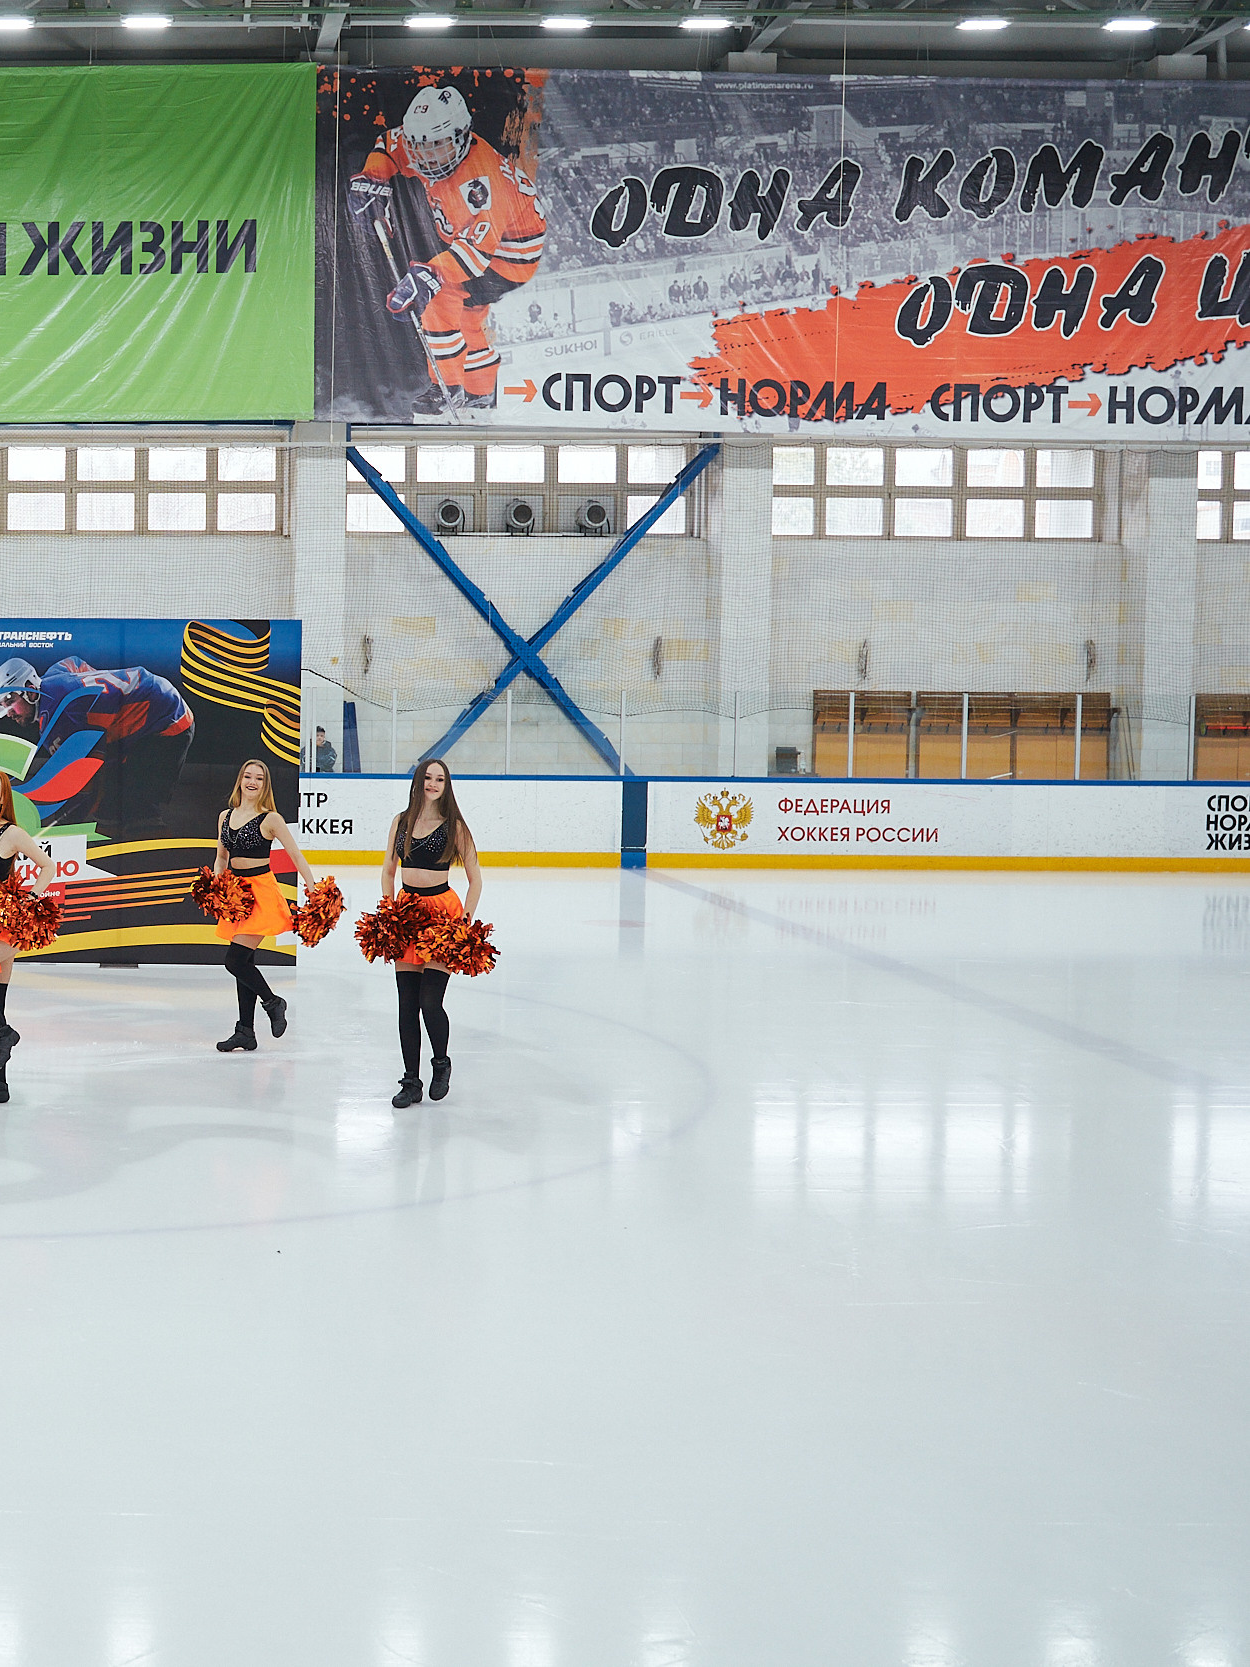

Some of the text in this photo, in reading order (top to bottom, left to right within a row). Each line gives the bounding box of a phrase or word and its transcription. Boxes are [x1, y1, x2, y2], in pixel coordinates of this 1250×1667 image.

[714, 80, 814, 91] www.platinumarena.ru
[590, 157, 862, 249] ОДНА
[893, 128, 1250, 224] КОМАН
[18, 219, 258, 276] ЖИЗНИ
[896, 254, 1166, 348] ОДНА
[638, 325, 680, 341] ERIELL
[544, 338, 598, 358] SUKHOI
[542, 372, 1250, 425] СПОРТ НОРМА СПОРТ НОРМ
[299, 793, 328, 807] ТР
[778, 797, 891, 816] ФЕДЕРАЦИЯ
[1207, 795, 1250, 812] СПО
[298, 818, 353, 835] ККЕЯ
[1206, 814, 1250, 831] НОР
[777, 826, 939, 843] ХОККЕЯ РОССИИ
